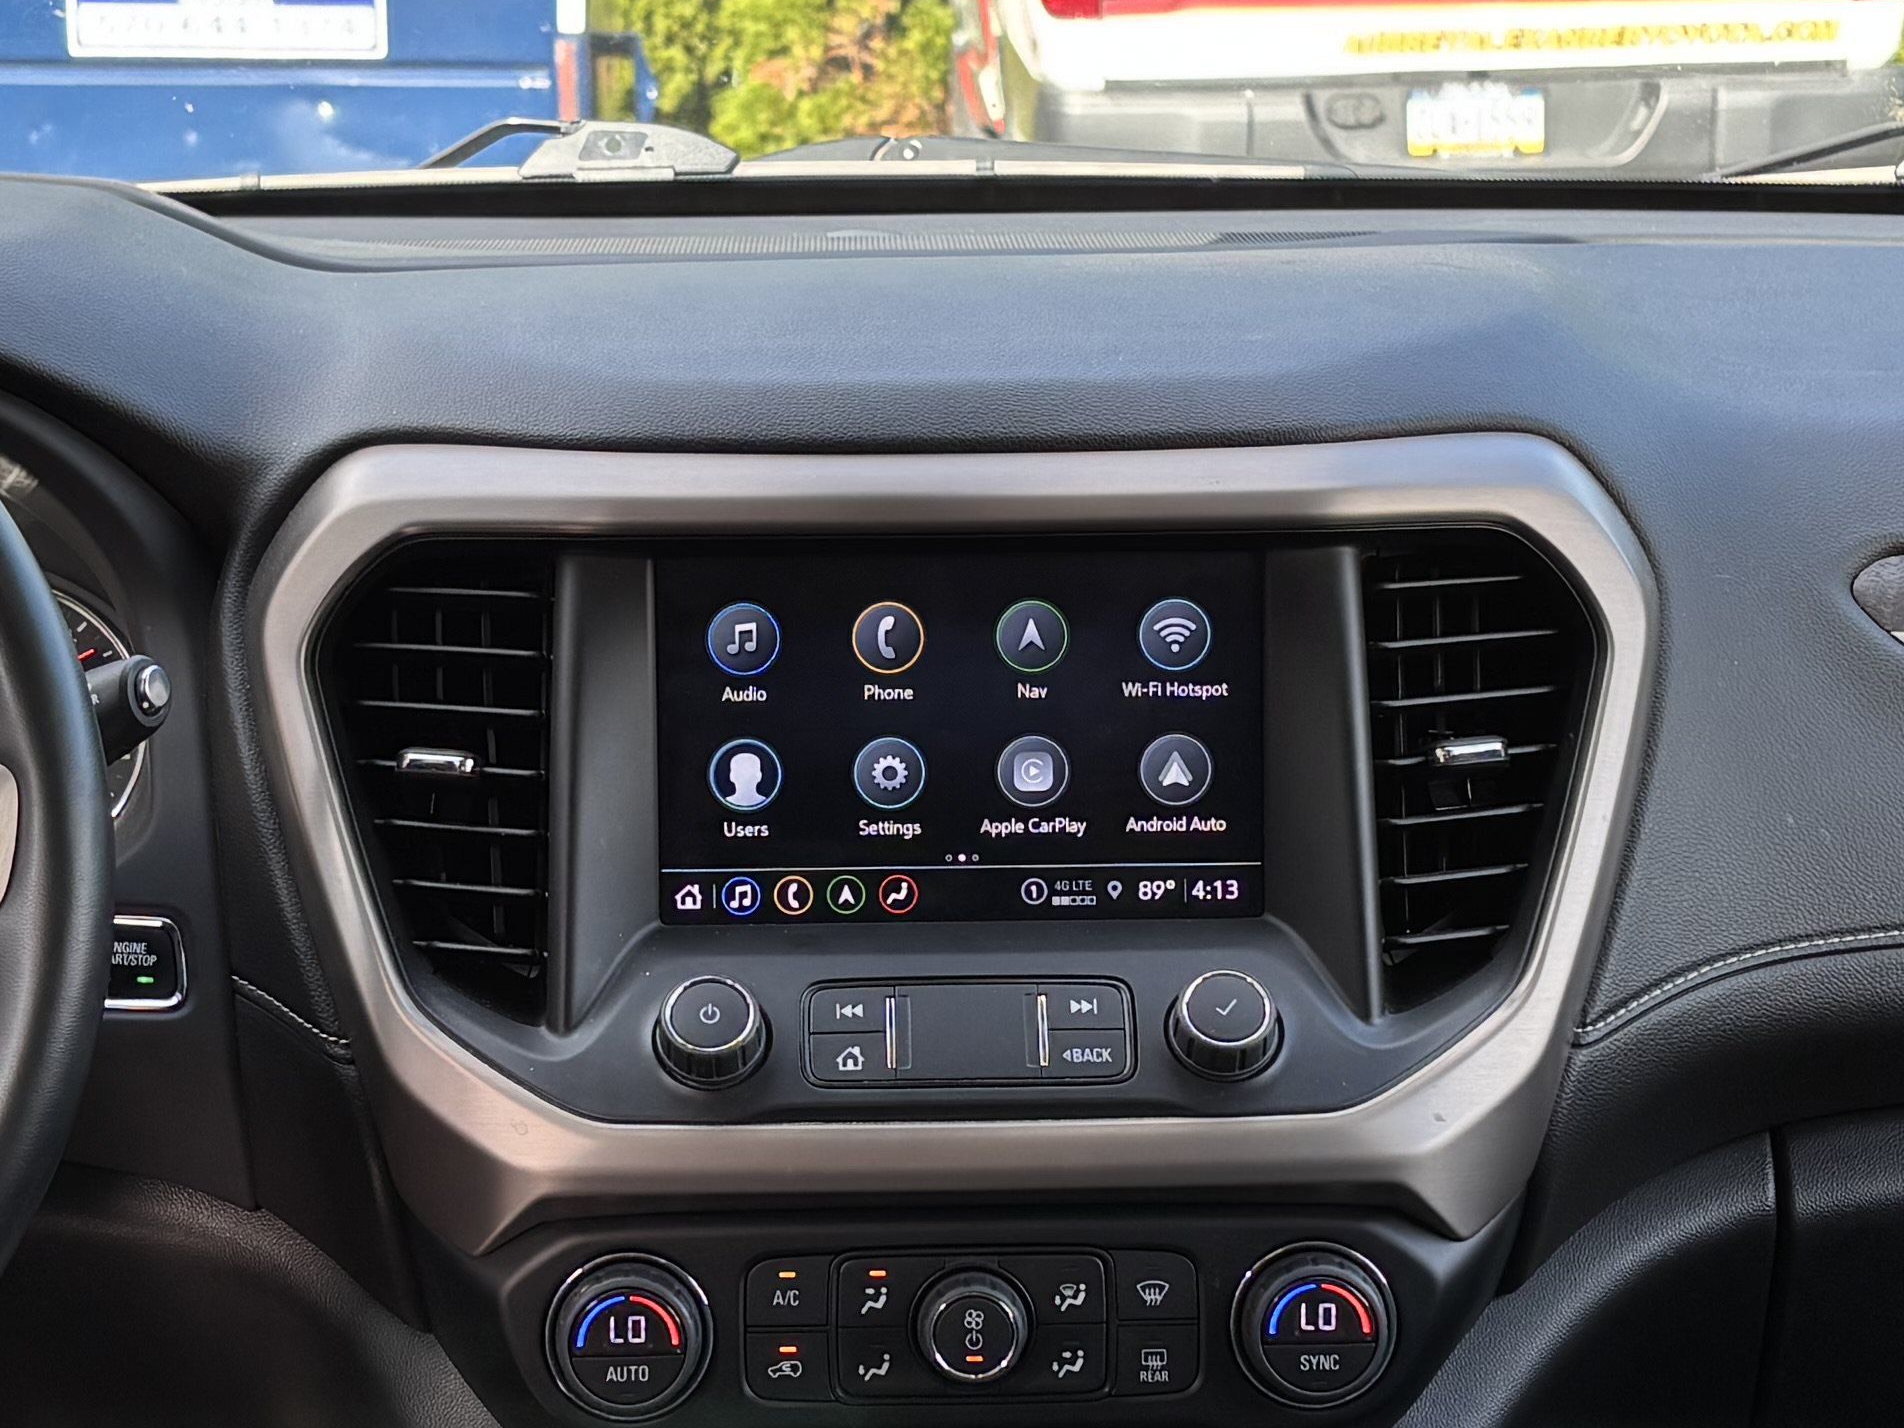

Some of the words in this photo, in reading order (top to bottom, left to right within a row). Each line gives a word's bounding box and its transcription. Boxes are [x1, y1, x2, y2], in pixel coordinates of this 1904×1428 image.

[721, 685, 768, 704] Audio
[863, 684, 914, 702] Phone
[1017, 683, 1048, 700] Nav
[1122, 681, 1162, 699] Wi-Fi
[1166, 681, 1229, 702] Hotspot
[723, 821, 770, 838] Users
[858, 819, 922, 839] Settings
[980, 817, 1024, 838] Apple
[1027, 816, 1087, 838] CarPlay
[1125, 815, 1187, 833] Android
[1189, 815, 1227, 833] Auto
[1053, 880, 1070, 891] 4G
[1072, 880, 1093, 891] LTE
[1191, 879, 1240, 901] 4:13
[113, 941, 148, 954] NGINE
[111, 953, 158, 967] RT/STOP
[1072, 1046, 1113, 1065] BACK
[772, 1288, 801, 1308] A/C
[1300, 1302, 1337, 1332] LO
[609, 1315, 646, 1344] LO
[1299, 1354, 1340, 1371] SYNC
[605, 1364, 649, 1383] AUTO
[1139, 1370, 1170, 1383] REAR
